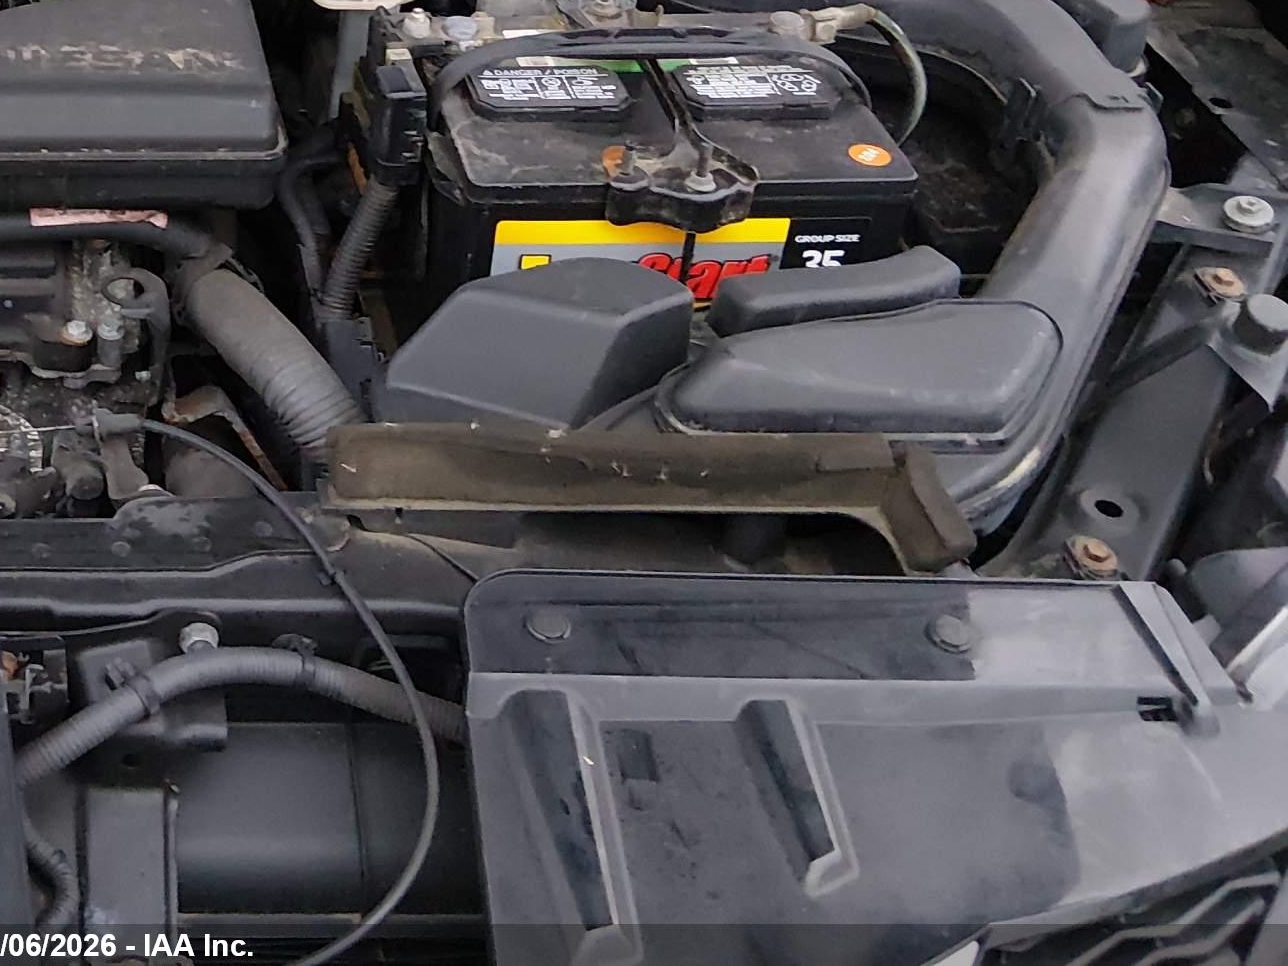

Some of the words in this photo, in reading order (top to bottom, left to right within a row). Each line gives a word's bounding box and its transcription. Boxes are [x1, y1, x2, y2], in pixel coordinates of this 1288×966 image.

[795, 235, 835, 243] GROUP
[835, 234, 861, 243] SIZE
[802, 250, 845, 268] 35
